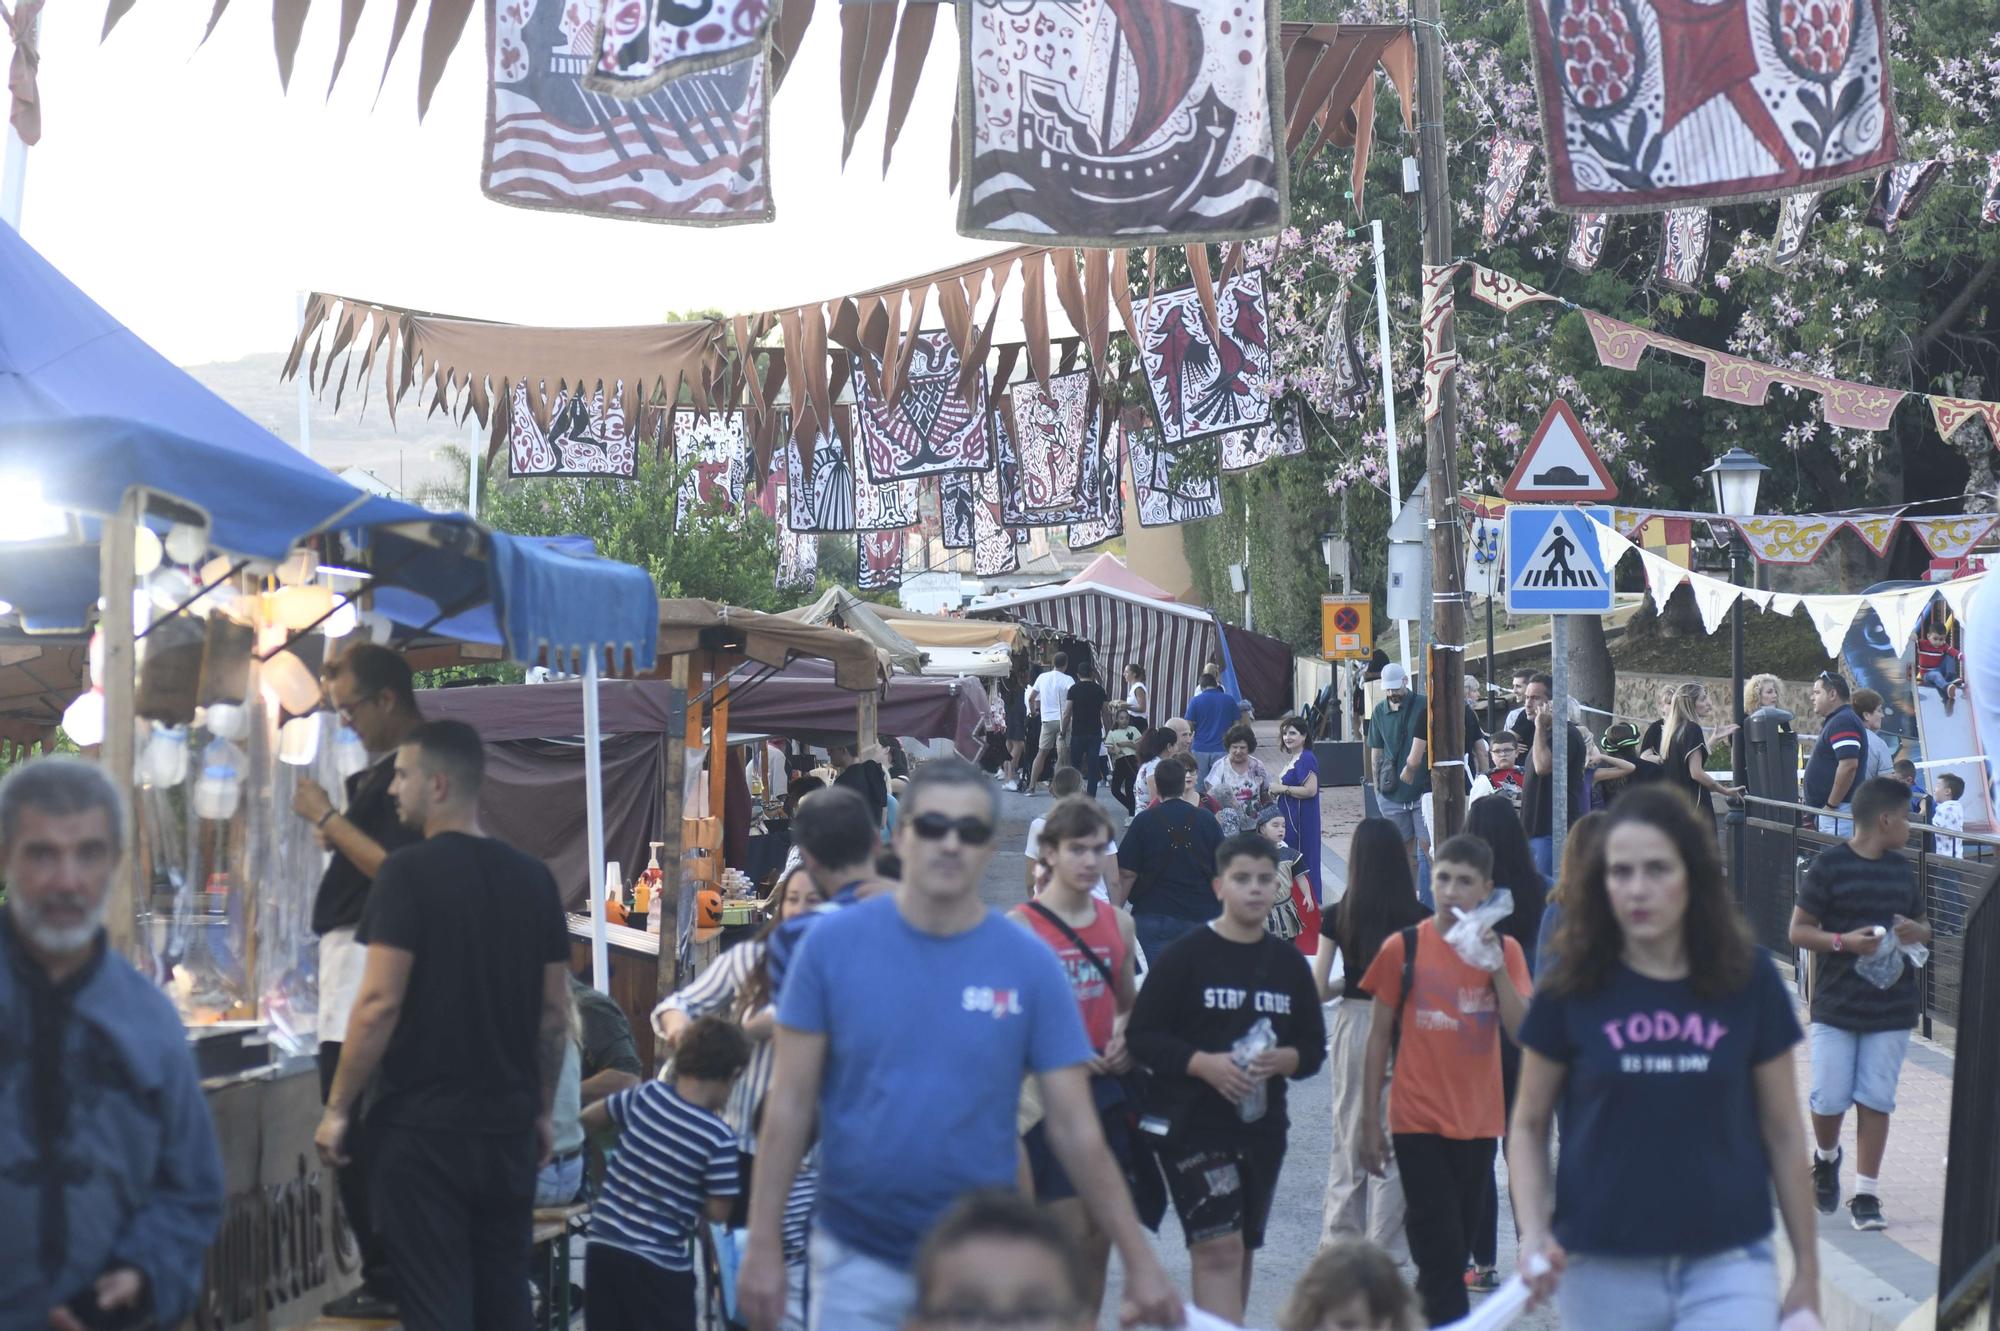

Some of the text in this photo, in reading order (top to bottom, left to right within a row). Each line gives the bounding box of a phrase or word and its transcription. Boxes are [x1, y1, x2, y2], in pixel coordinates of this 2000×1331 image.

[1204, 987, 1247, 1009] STAY
[1603, 1009, 1729, 1050] TODAY
[1678, 1053, 1710, 1072] DAY
